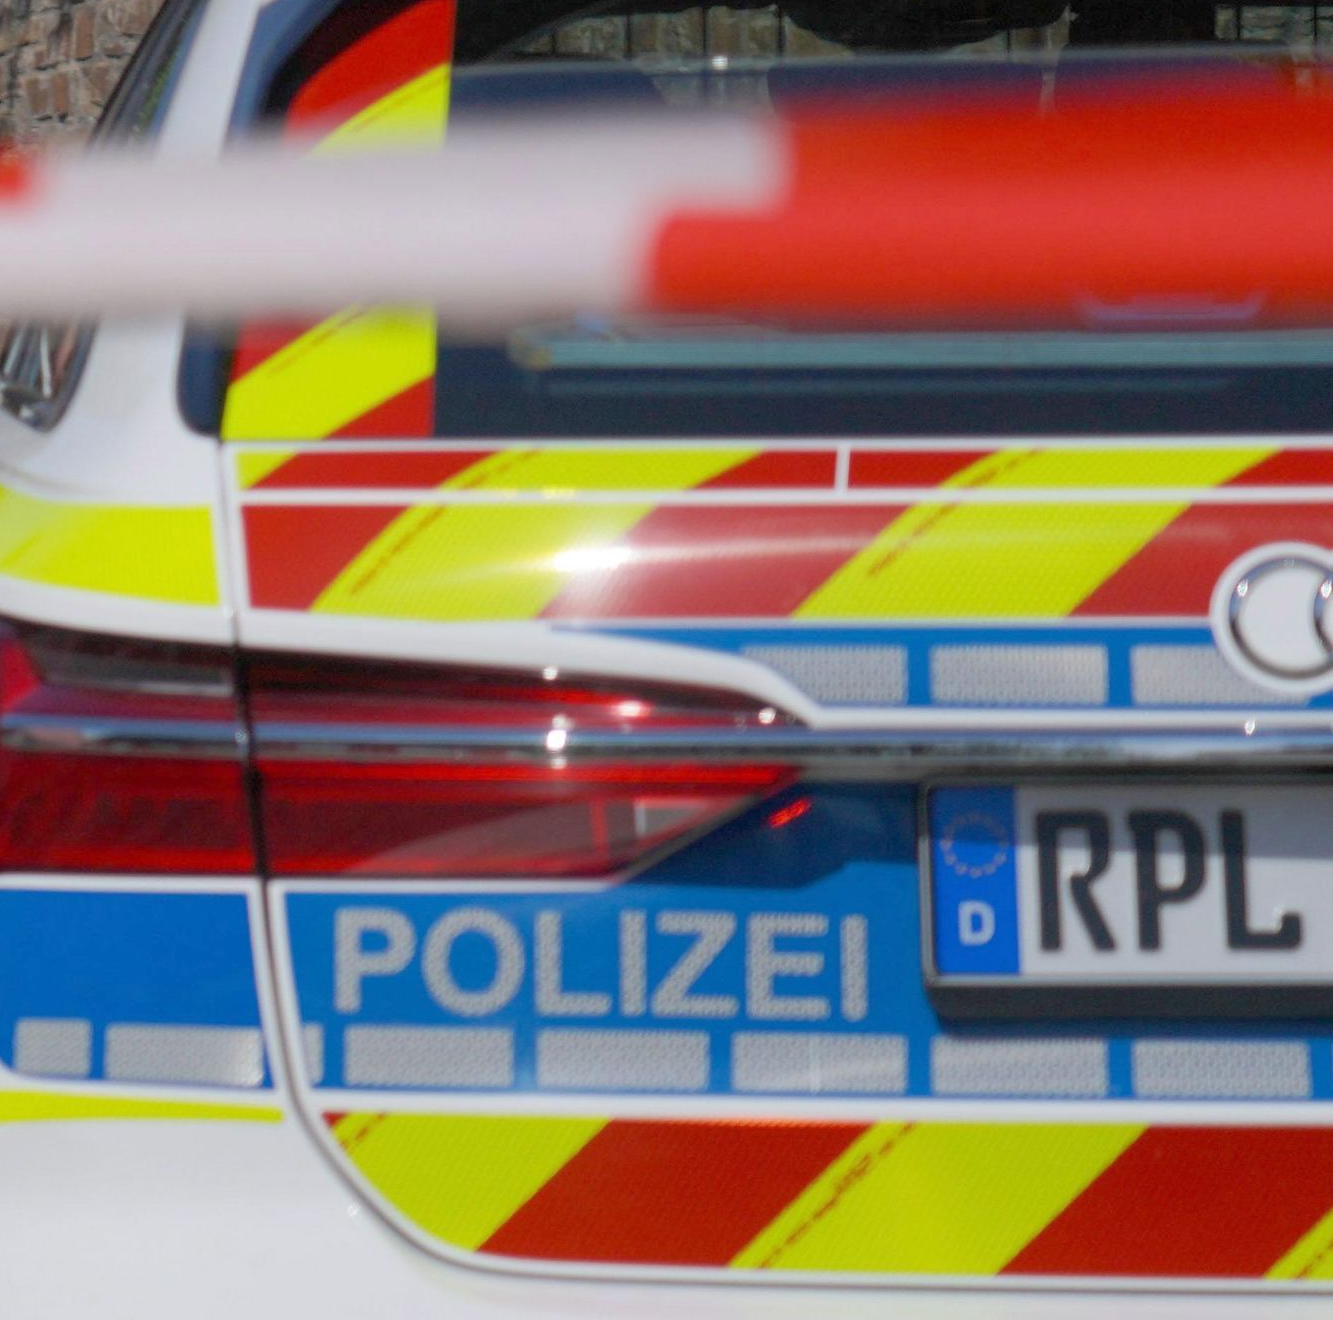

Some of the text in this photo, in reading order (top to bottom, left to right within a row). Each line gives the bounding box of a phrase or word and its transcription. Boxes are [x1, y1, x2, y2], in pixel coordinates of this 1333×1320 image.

[958, 900, 996, 946] D
[1035, 808, 1303, 952] RPL
[334, 906, 870, 1023] POLIZEI
